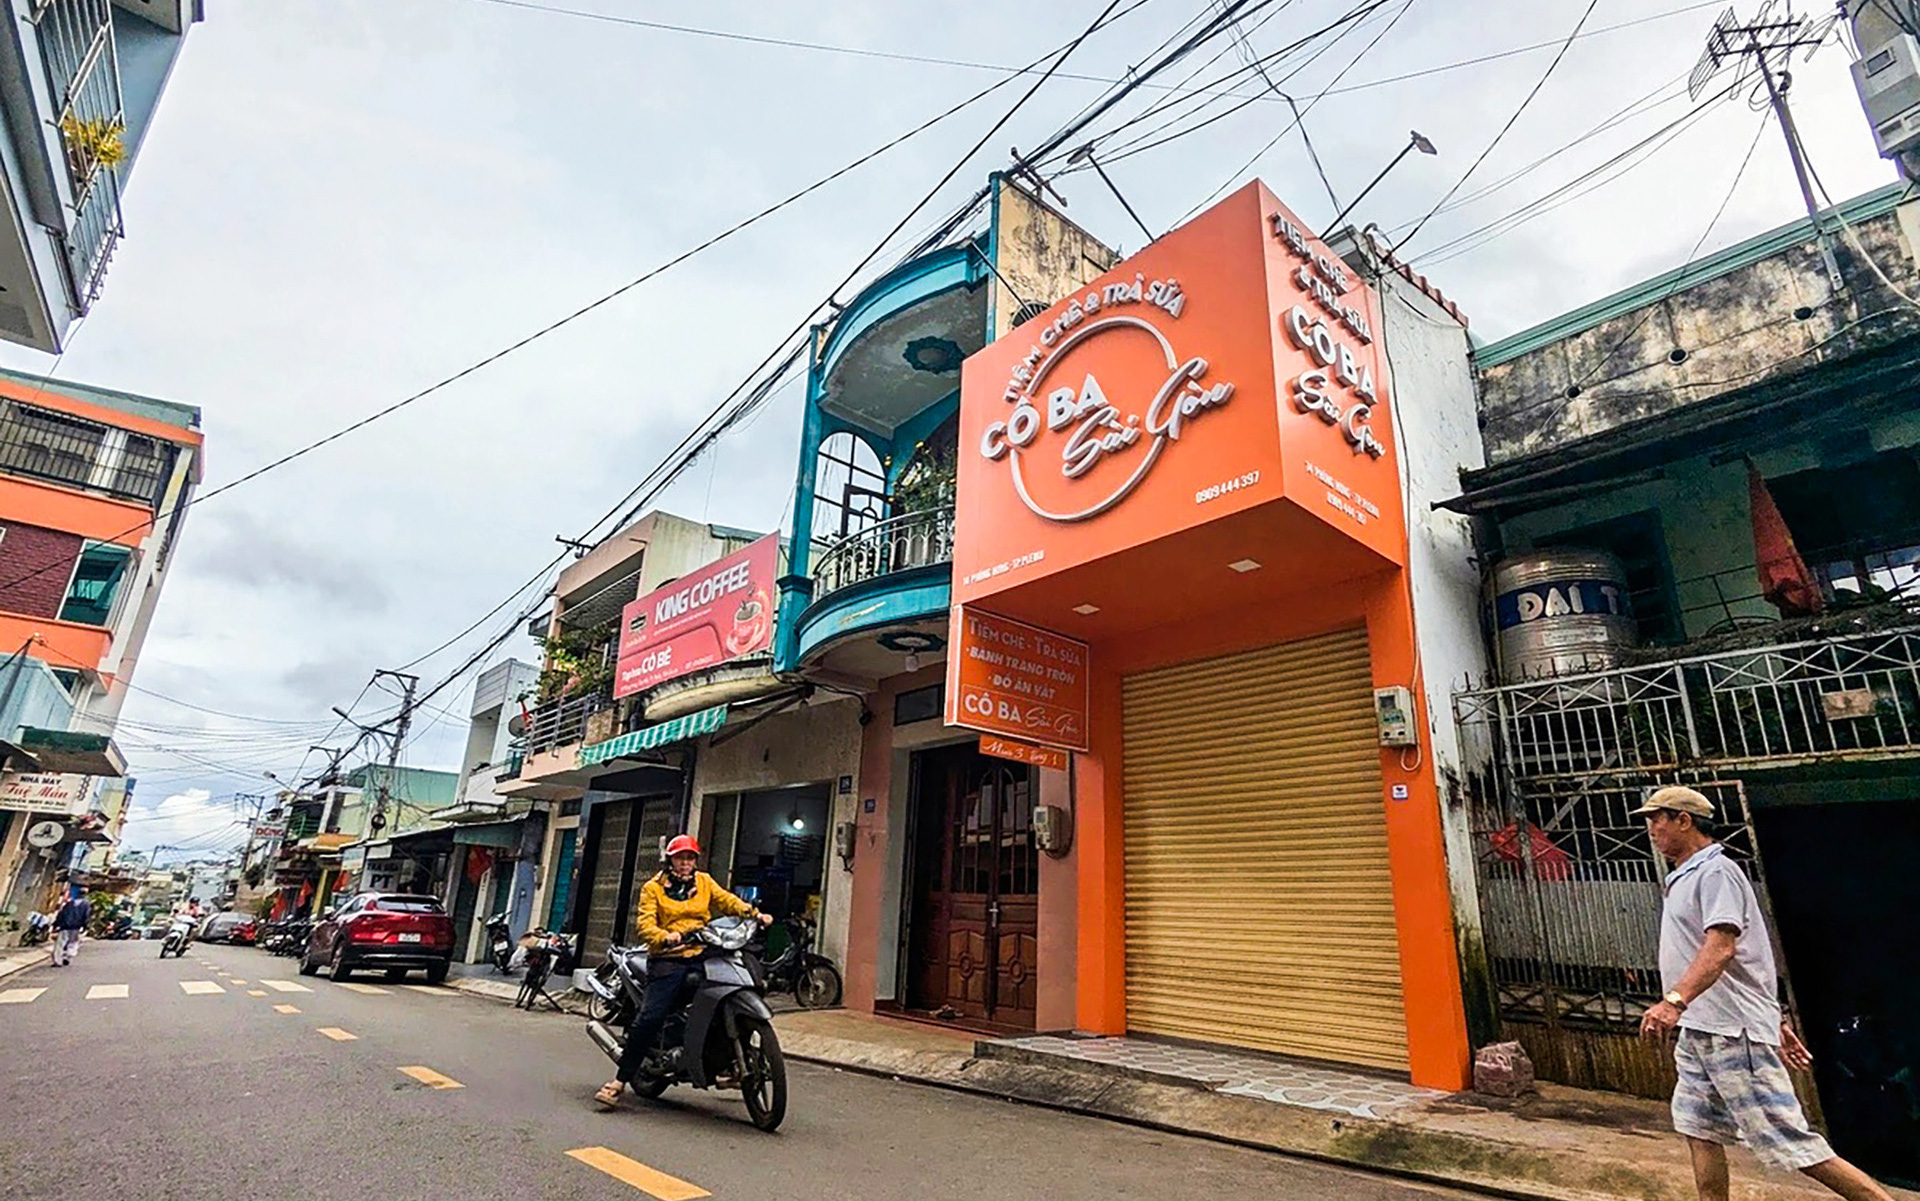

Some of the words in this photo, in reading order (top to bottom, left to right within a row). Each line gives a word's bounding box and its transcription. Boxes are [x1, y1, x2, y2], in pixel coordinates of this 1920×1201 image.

[1084, 293, 1100, 314] &
[1334, 343, 1378, 406] BA
[980, 395, 1040, 460] CÔ
[1048, 373, 1109, 431] BA
[654, 588, 690, 625] KING
[690, 559, 751, 608] COFFEE
[1001, 631, 1026, 649] CHÈ
[964, 692, 993, 716] CÔ
[998, 701, 1022, 723] BA
[1014, 747, 1024, 759] 3
[1052, 753, 1058, 766] 1
[369, 873, 393, 888] PT
